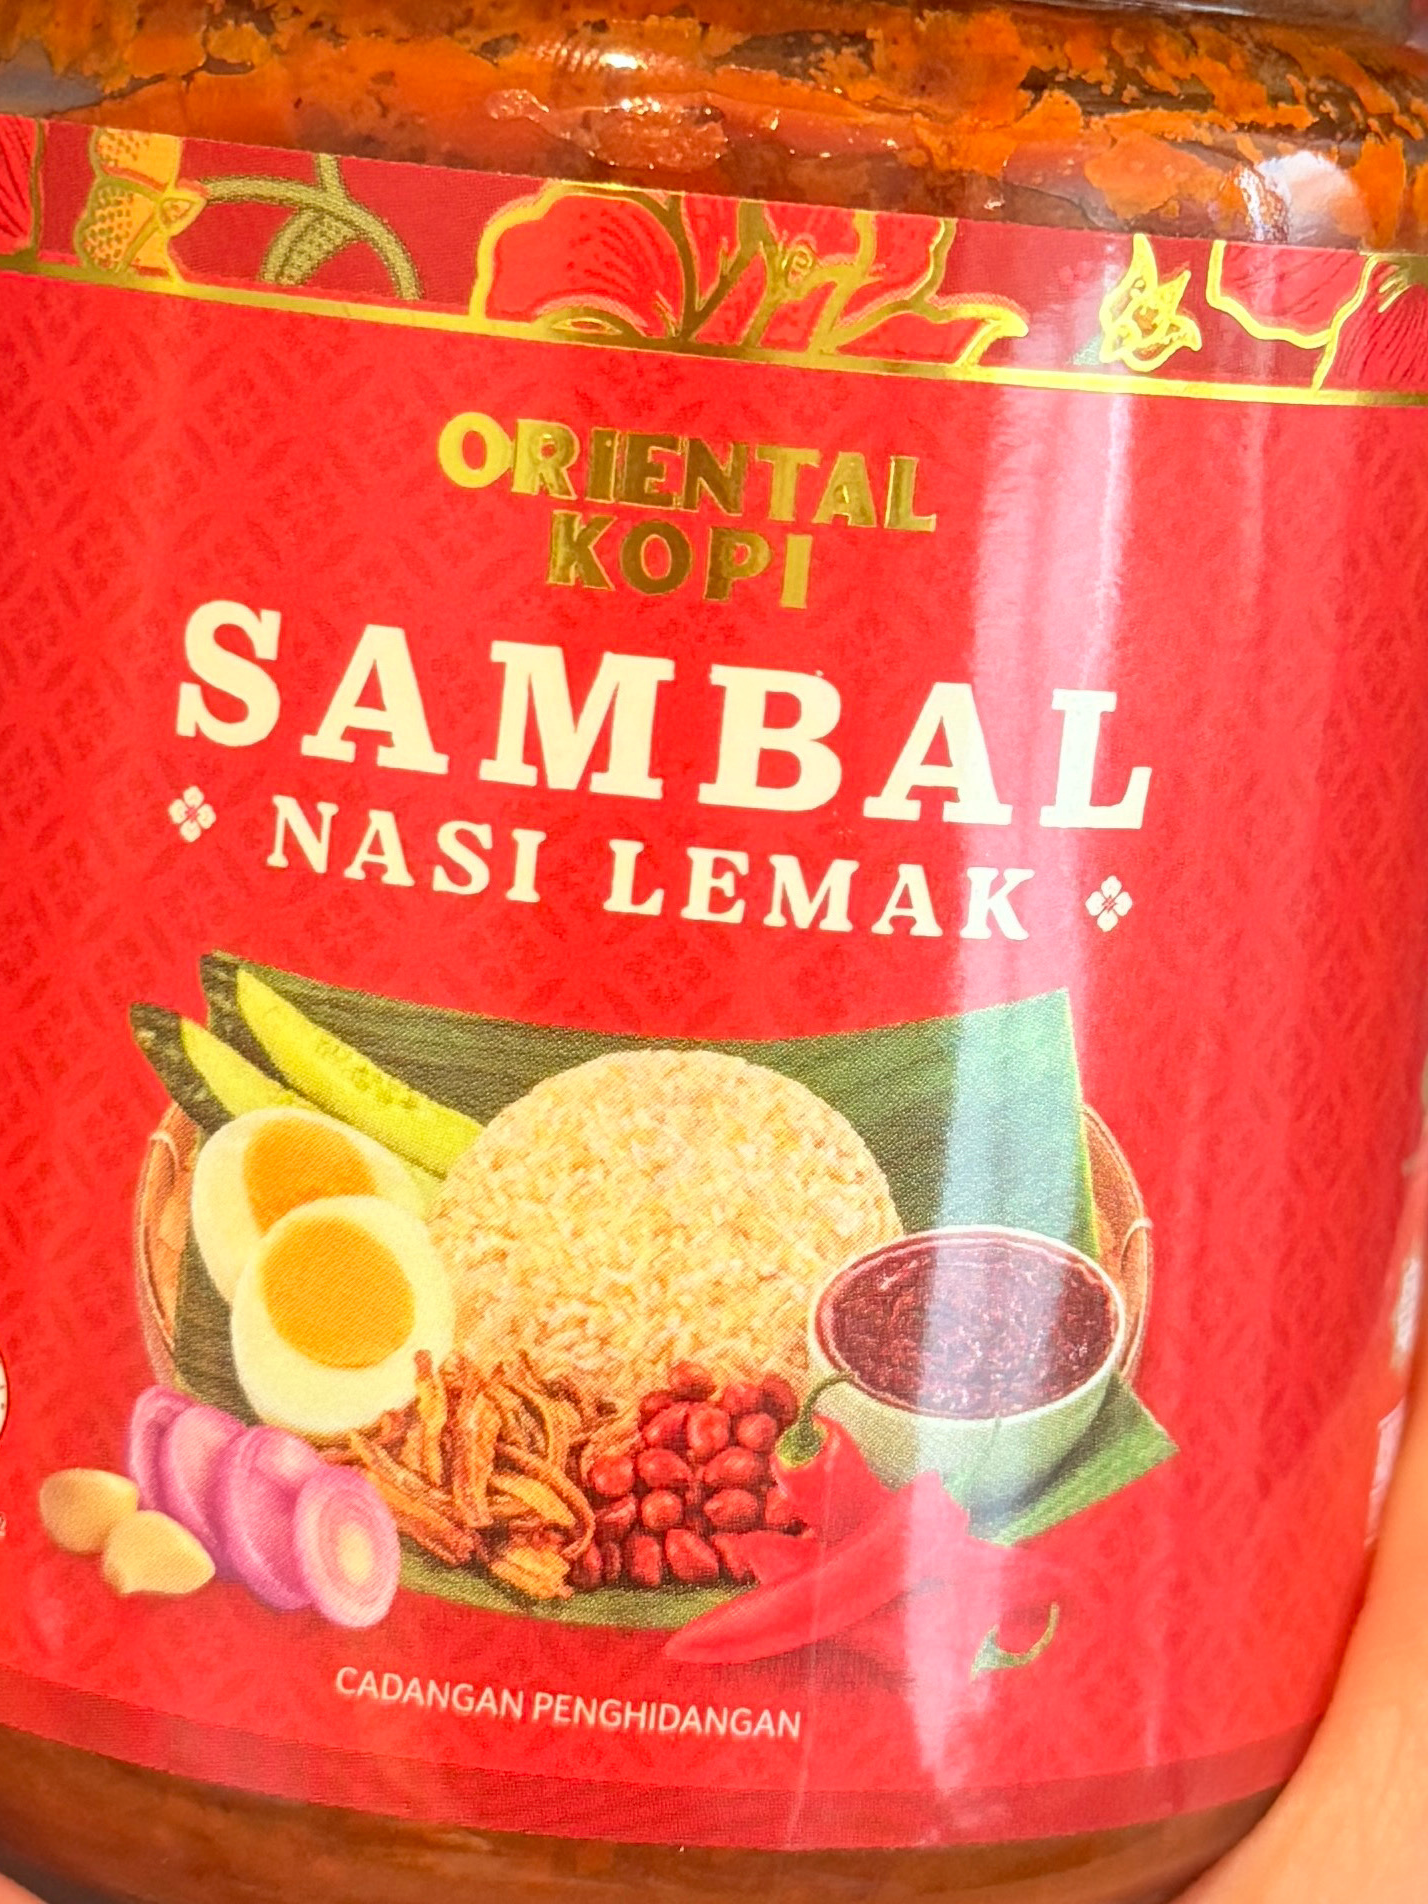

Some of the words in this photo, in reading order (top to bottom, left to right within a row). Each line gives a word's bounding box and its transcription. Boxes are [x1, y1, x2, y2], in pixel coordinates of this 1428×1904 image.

[438, 412, 935, 533] ORIENTAL
[547, 510, 812, 609] KOPI
[174, 598, 1153, 830] SAMBAL
[266, 793, 546, 904] NASI
[604, 839, 1035, 940] LEMAK
[335, 1666, 523, 1719] CADANGAN
[533, 1694, 802, 1741] PENGHIDANGAN
